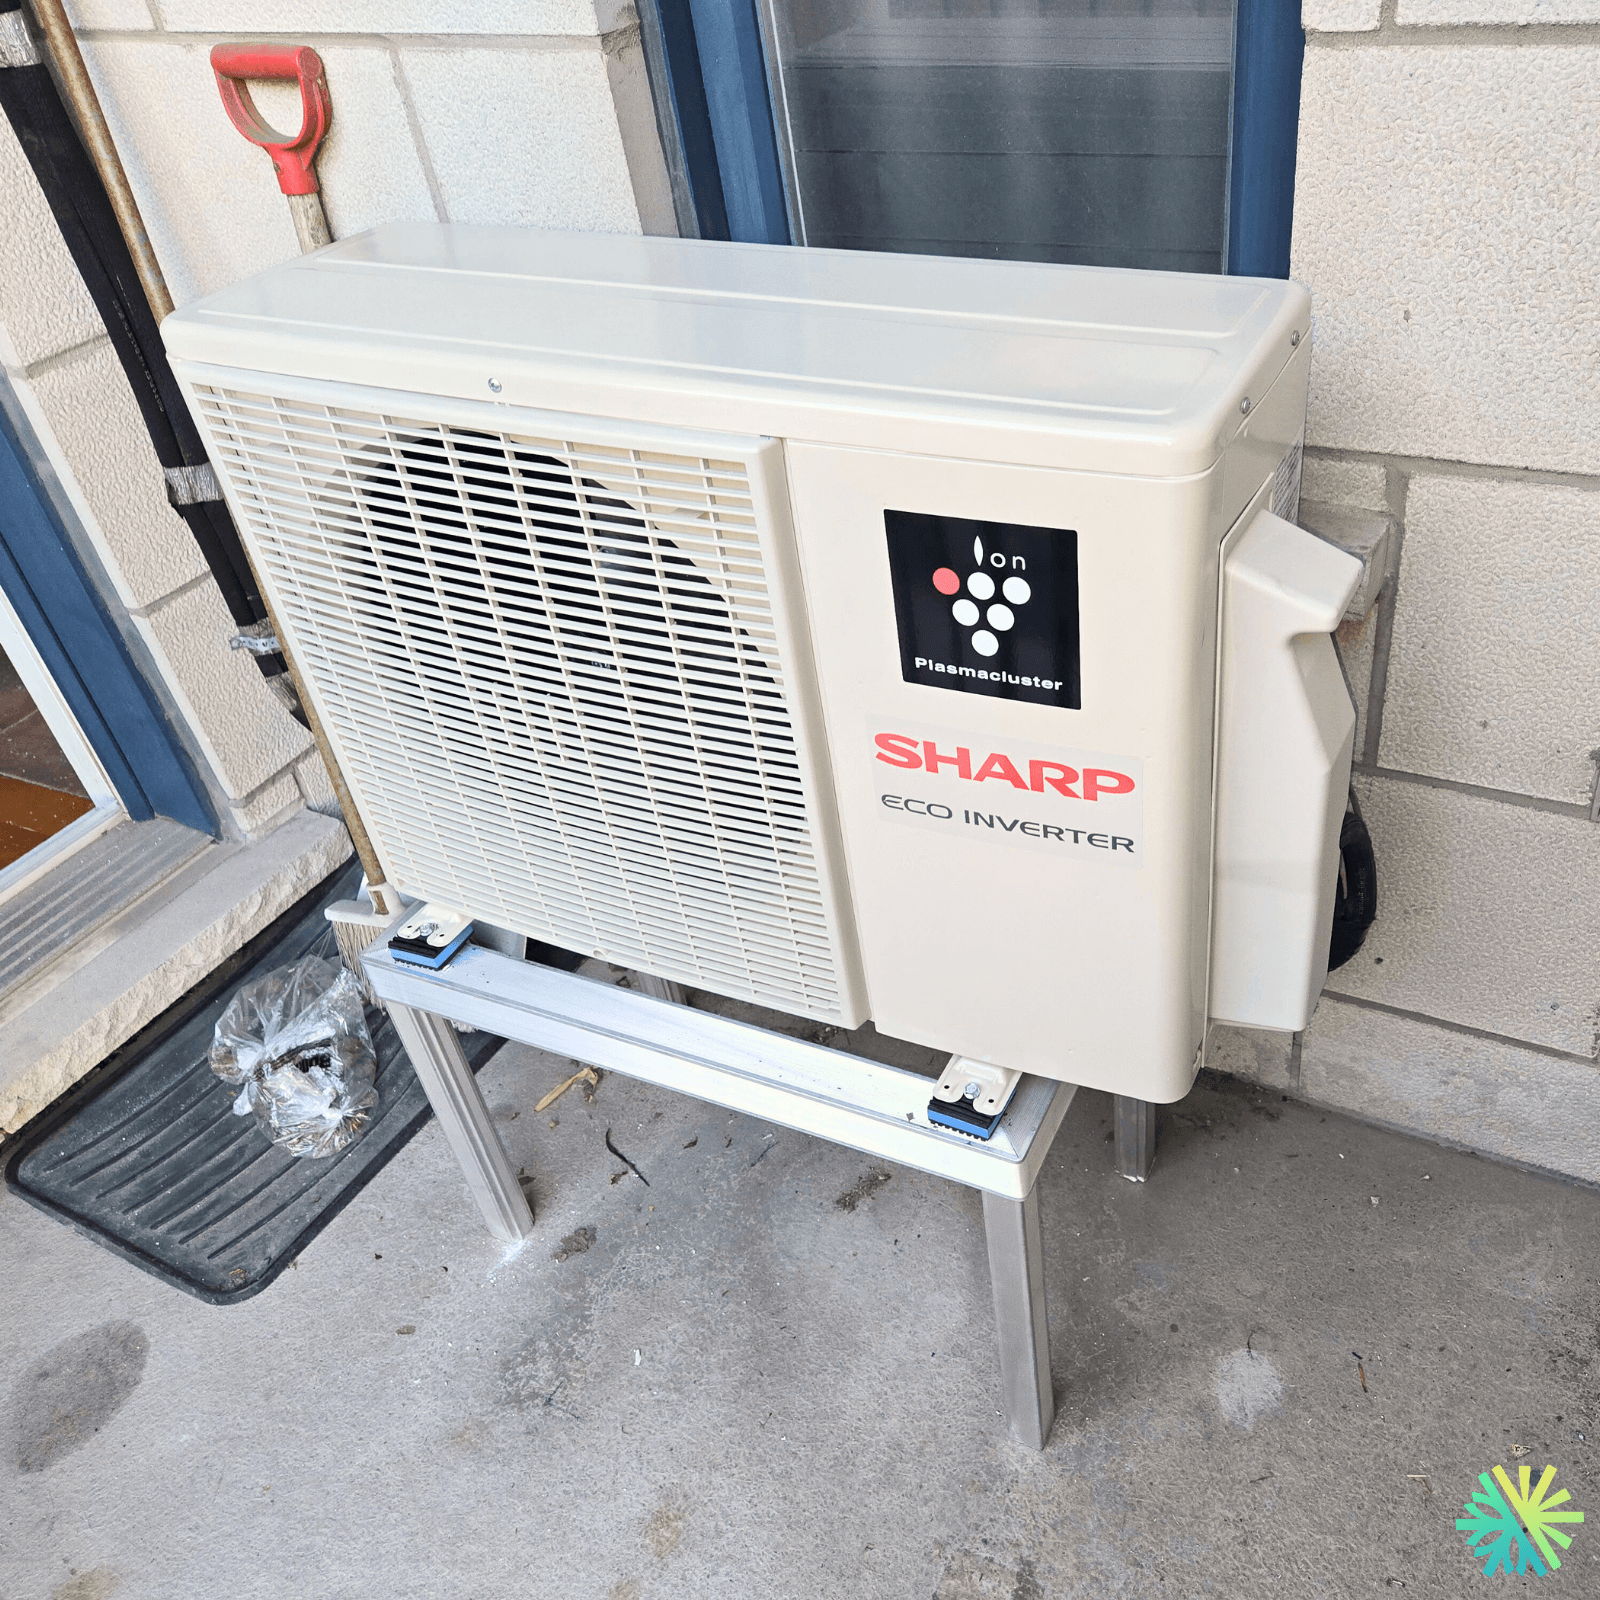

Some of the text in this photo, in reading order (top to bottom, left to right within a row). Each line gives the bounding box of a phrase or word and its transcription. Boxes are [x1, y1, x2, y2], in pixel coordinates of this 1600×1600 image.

[973, 535, 1026, 571] Ion
[914, 656, 1063, 691] Plasmacluster
[874, 733, 1136, 801] SHARP
[881, 794, 1135, 853] ECO INVERTER
